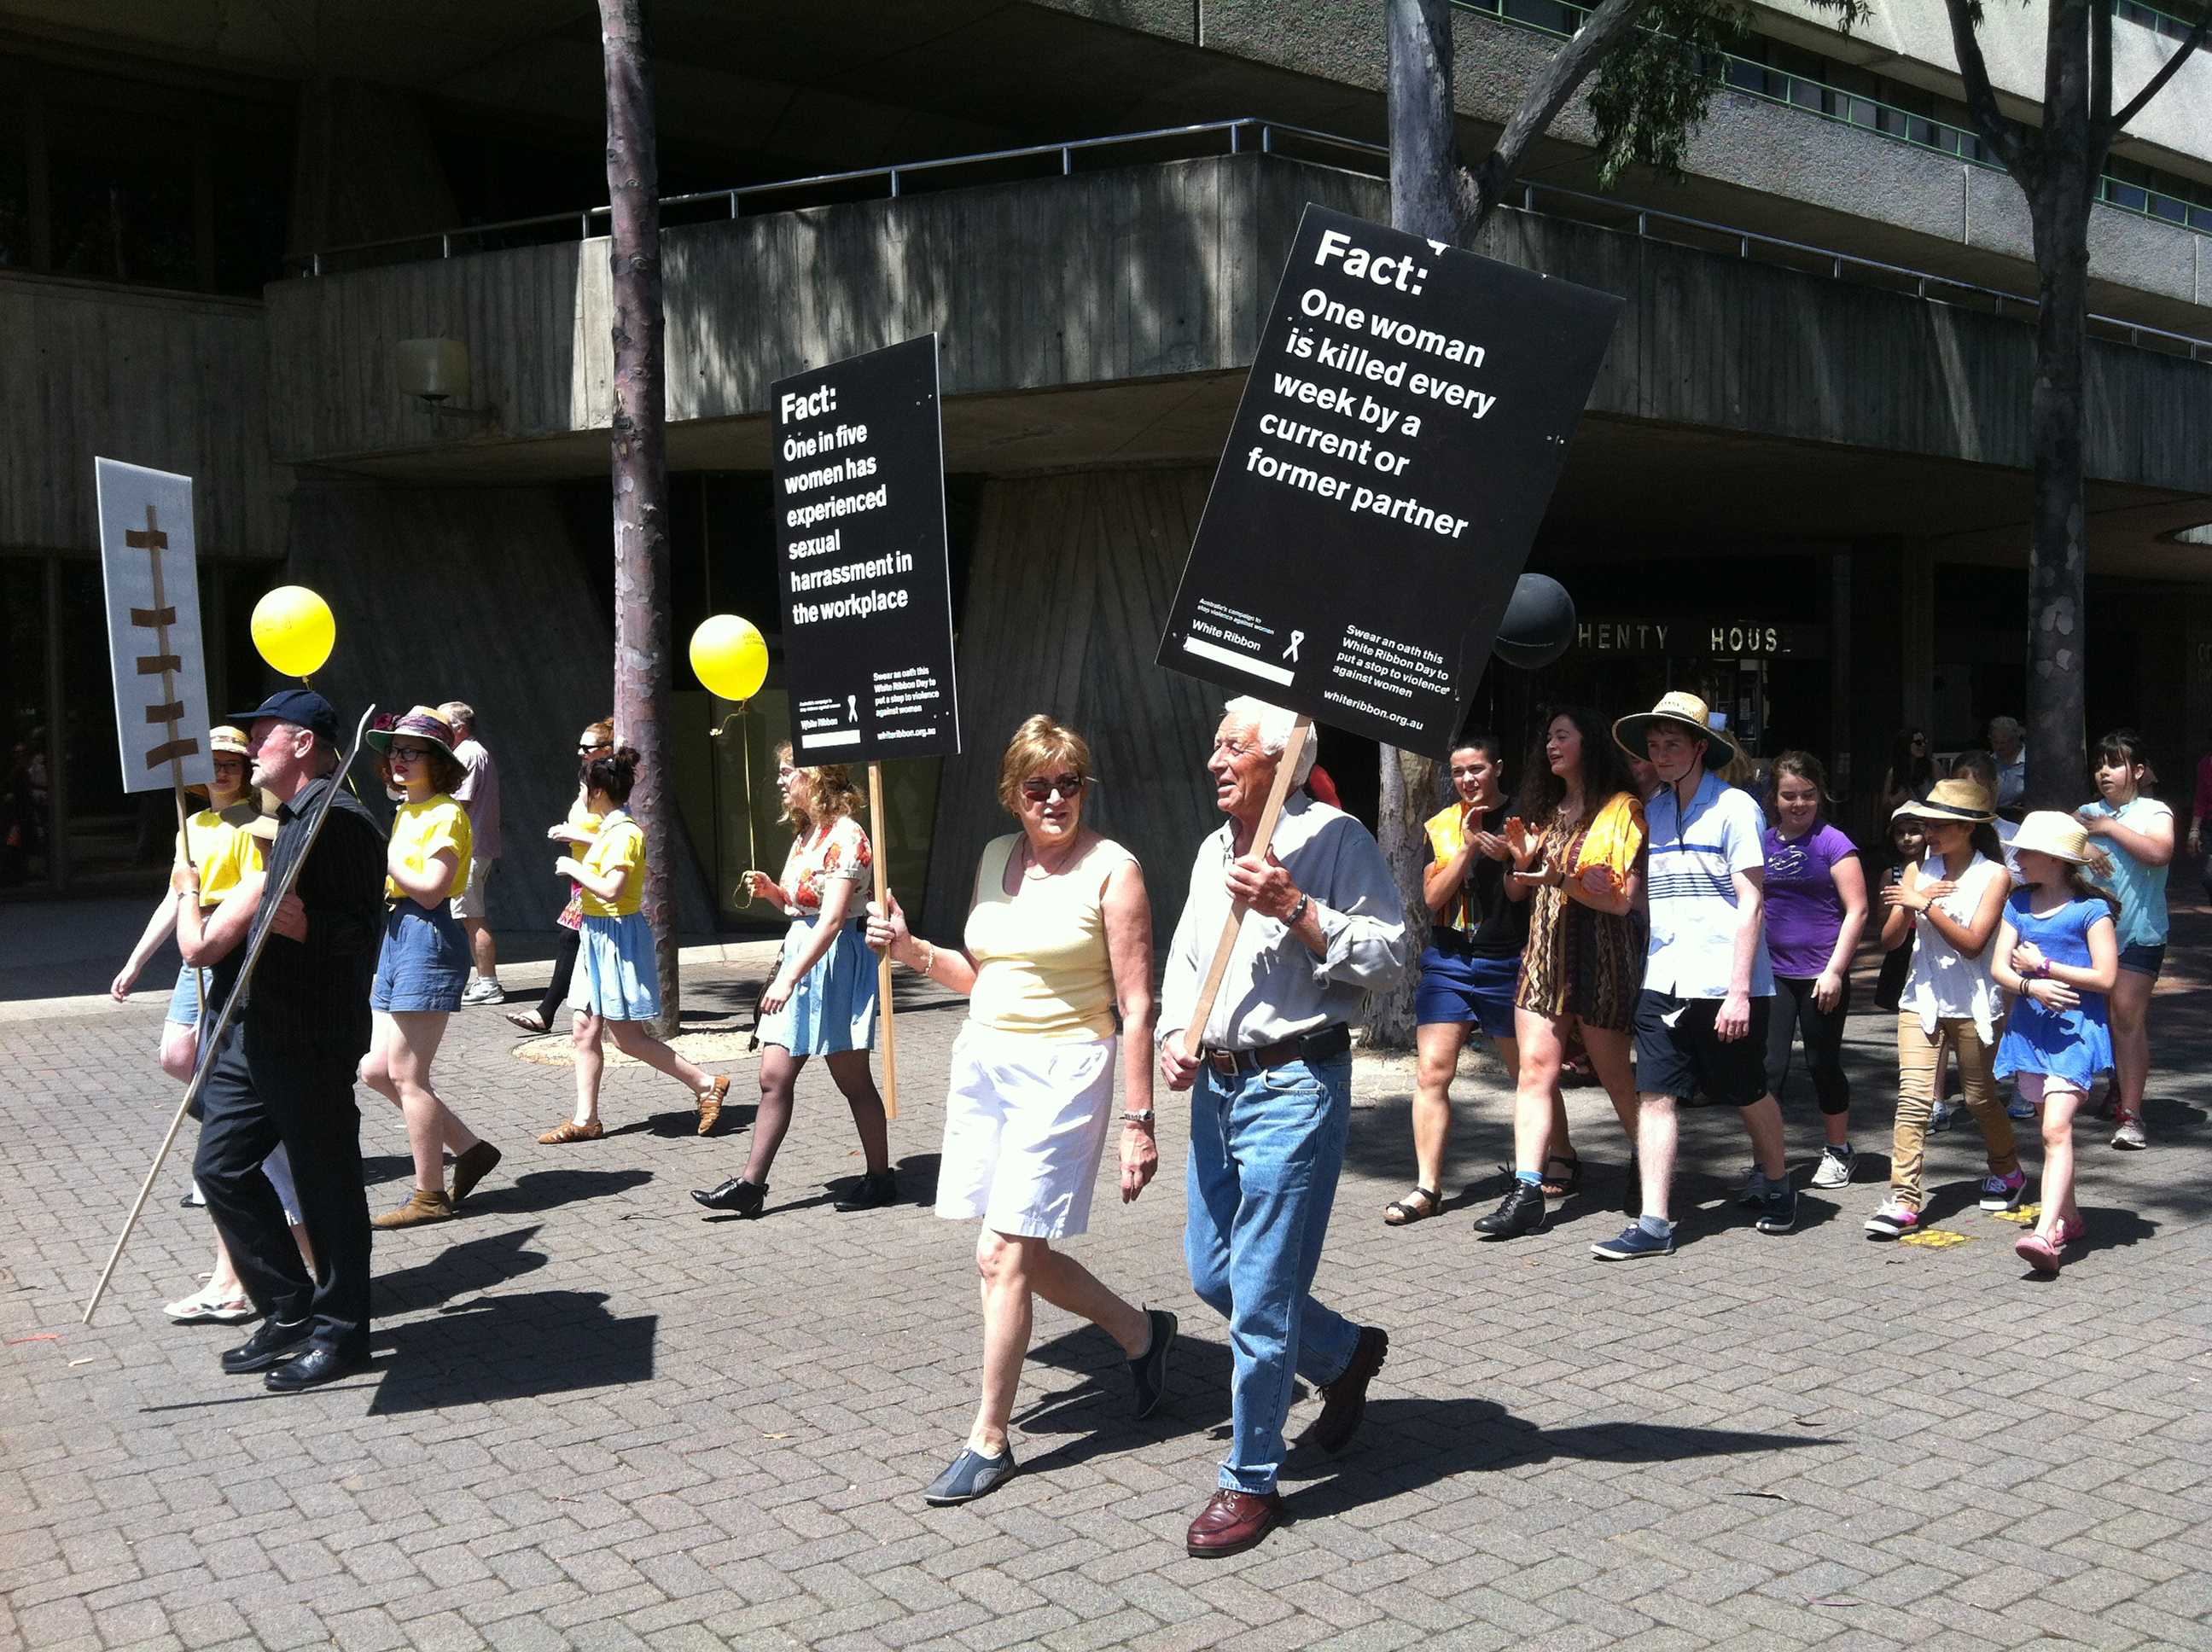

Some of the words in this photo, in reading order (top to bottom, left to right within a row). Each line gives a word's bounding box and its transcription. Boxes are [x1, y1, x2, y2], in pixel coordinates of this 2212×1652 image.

[1314, 230, 1428, 295] Fact:
[1301, 288, 1365, 329] One
[1371, 314, 1486, 368] woman
[1285, 328, 1314, 358] is
[1317, 337, 1407, 387] killed
[1409, 373, 1495, 419] every
[782, 385, 836, 424] Fact:
[1274, 373, 1357, 416] week
[1359, 395, 1400, 433] by
[1401, 415, 1422, 437] a
[783, 438, 817, 462] One
[818, 431, 834, 452] in
[835, 424, 868, 448] five
[1260, 414, 1371, 465] current
[1374, 451, 1410, 476] or
[784, 464, 843, 494] women
[846, 457, 876, 480] has
[1246, 447, 1351, 501] former
[1350, 486, 1469, 538] partner
[787, 484, 887, 528] experienced
[789, 528, 841, 560] sexual
[790, 553, 894, 592] harrassment
[896, 550, 912, 573] in
[792, 602, 818, 625] the
[820, 589, 908, 619] workplace
[1191, 619, 1222, 637] White
[1223, 630, 1261, 651] Ribbon
[1346, 624, 1382, 643] Swear
[1382, 637, 1395, 649] an
[1396, 643, 1421, 657] oath
[1423, 649, 1444, 664] this
[1578, 623, 1668, 649] HENTY
[1711, 626, 1791, 653] HOUS
[873, 671, 894, 681] Swear
[917, 666, 929, 675] this
[1336, 652, 1356, 665] put
[1356, 658, 1364, 666] a
[1364, 660, 1389, 676] stop
[1389, 668, 1401, 679] to
[1342, 637, 1374, 655] White
[1374, 649, 1414, 669] Ribbon
[1415, 661, 1437, 678] Day
[1437, 670, 1449, 680] to
[916, 678, 928, 689] Day
[1332, 665, 1373, 684] against
[1373, 678, 1413, 698] women
[1324, 689, 1424, 730] whiteribbon.org.au
[876, 727, 936, 741] whiteribbon.org.au
